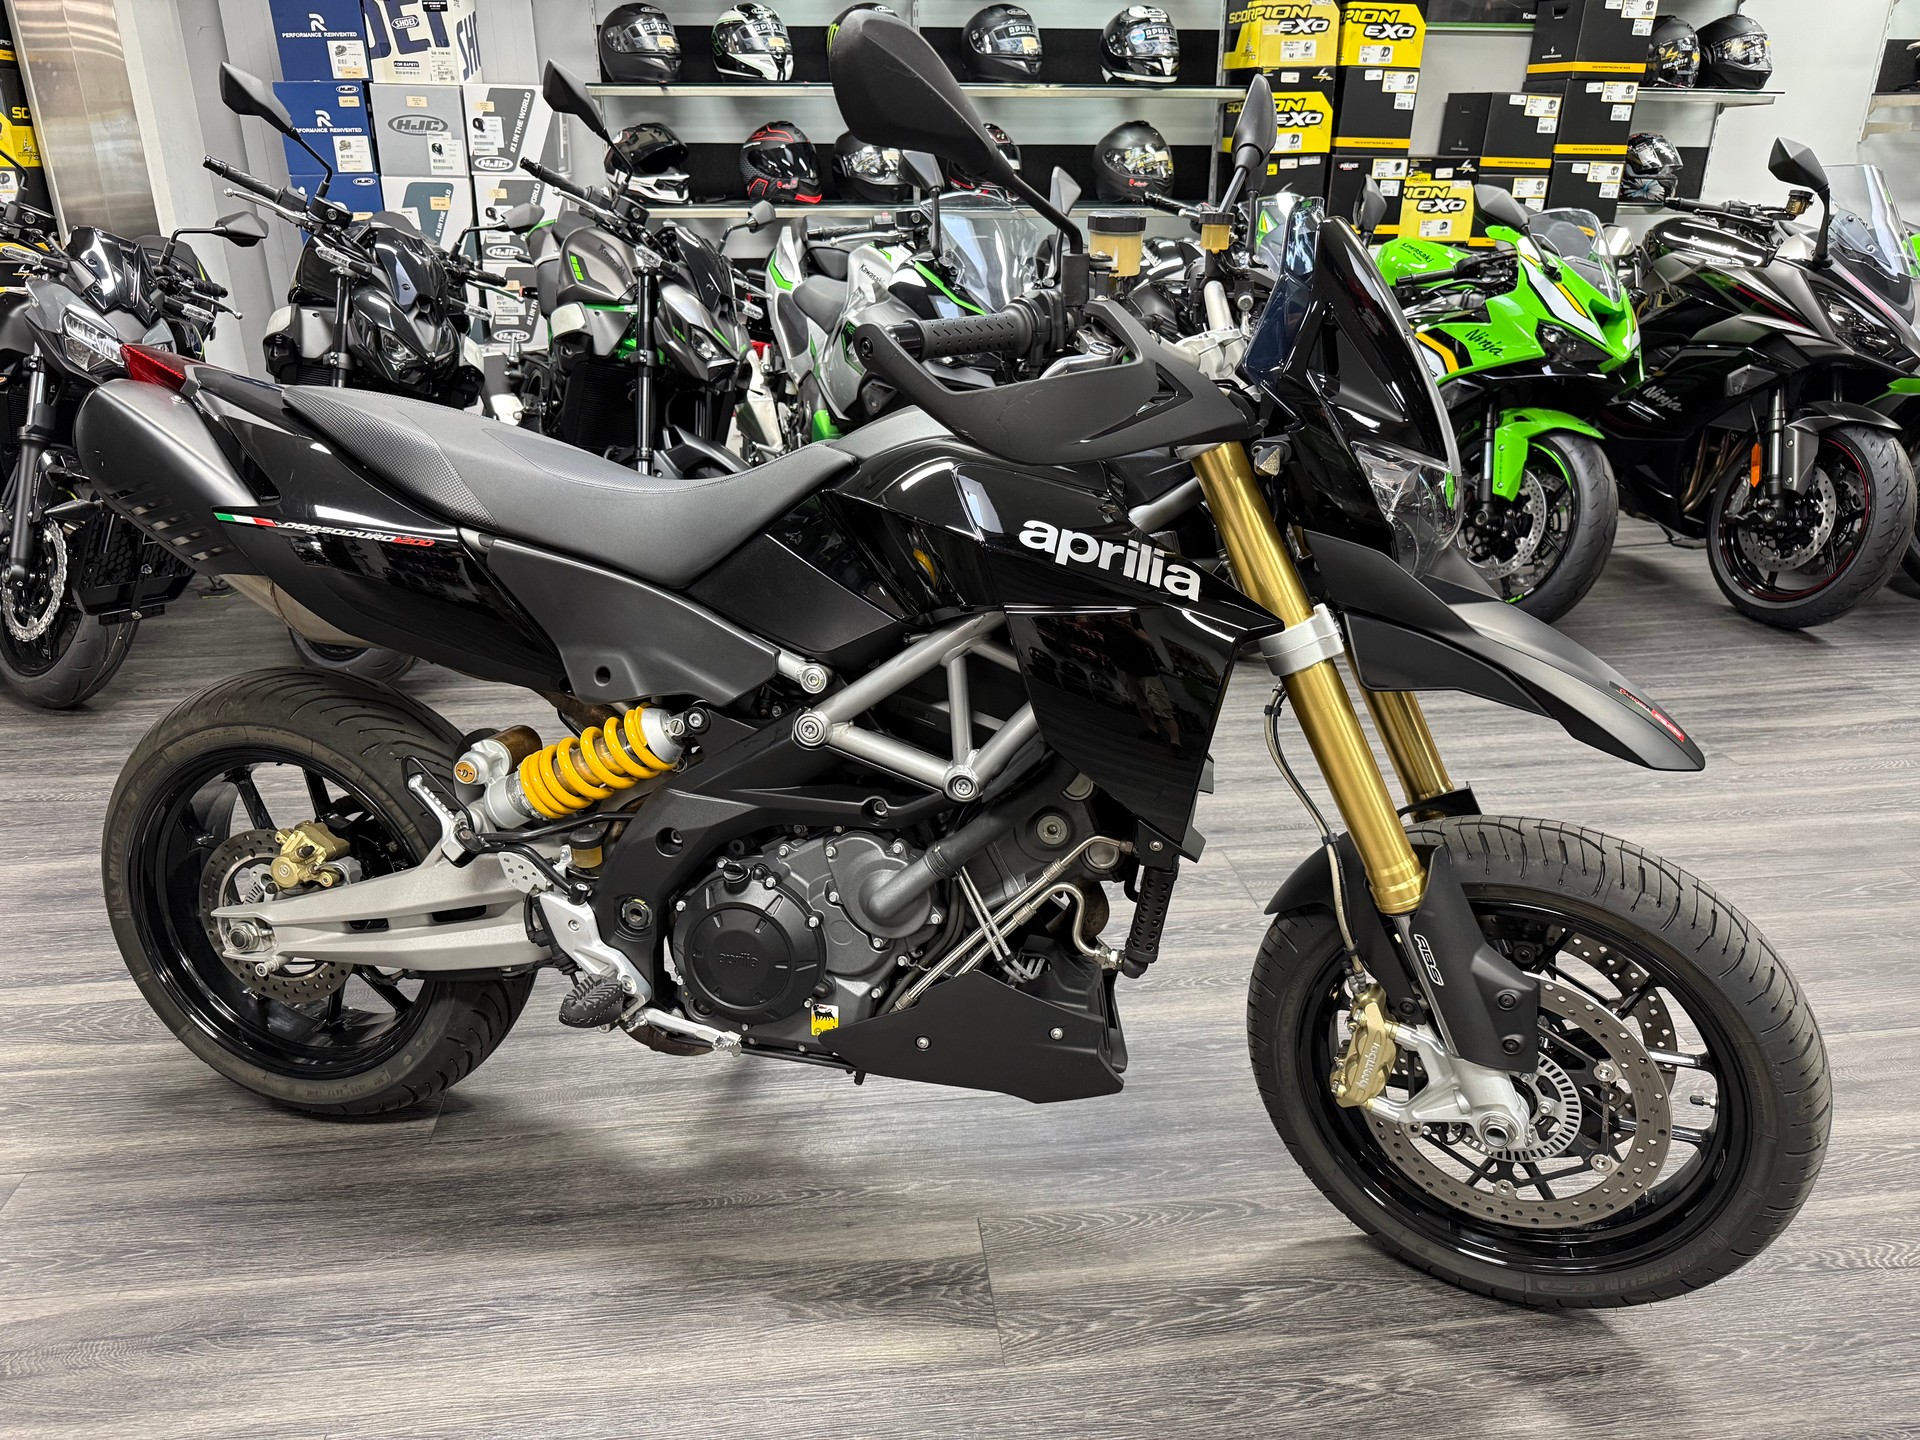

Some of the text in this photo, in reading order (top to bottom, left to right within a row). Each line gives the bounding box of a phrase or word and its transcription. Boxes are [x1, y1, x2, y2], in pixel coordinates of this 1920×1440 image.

[394, 16, 418, 28] SHOEI
[1228, 5, 1311, 24] SCORPION
[519, 92, 531, 119] WORLD
[396, 120, 440, 131] HJC
[515, 119, 524, 136] THE
[510, 142, 517, 153] #1
[480, 160, 508, 168] HJC
[491, 248, 519, 257] HJC
[1402, 242, 1434, 263] Kawasaki
[498, 331, 525, 341] HJC
[1465, 328, 1505, 358] Ninja
[1642, 386, 1682, 412] Ninja
[1018, 519, 1201, 603] aprilia
[719, 952, 759, 968] aprilia
[1413, 933, 1445, 987] ABS
[1356, 1041, 1381, 1090] brembo
